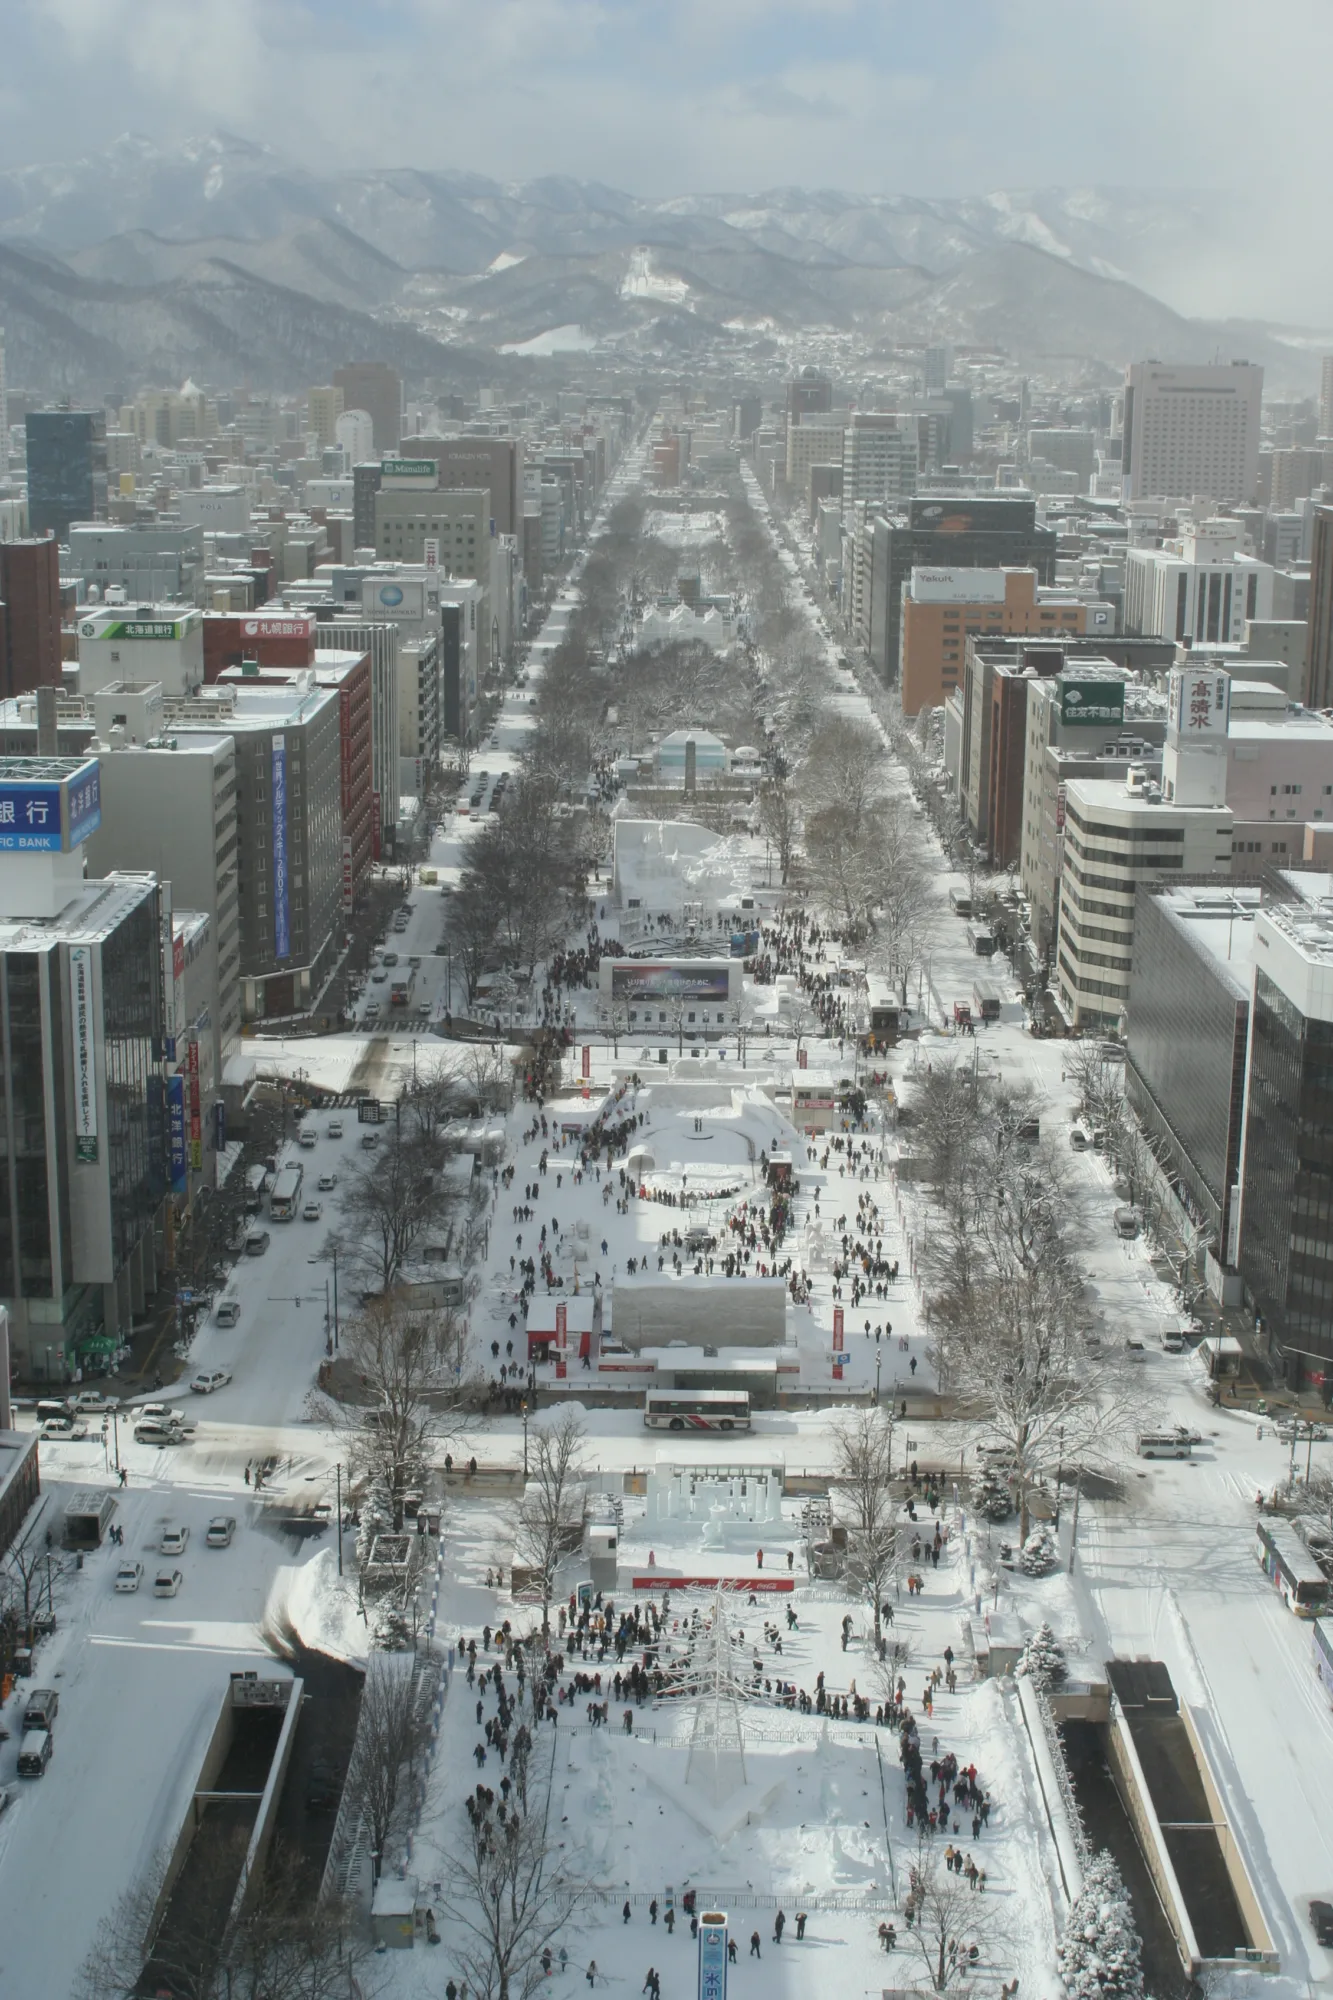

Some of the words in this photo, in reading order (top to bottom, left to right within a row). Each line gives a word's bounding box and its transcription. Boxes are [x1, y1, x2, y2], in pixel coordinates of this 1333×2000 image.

[394, 464, 431, 473] Manulife
[426, 541, 436, 568] 三井
[920, 574, 954, 583] Yakult
[1095, 612, 1106, 624] P
[125, 624, 173, 635] 北海道銀行
[260, 623, 304, 635] 札幌銀行
[1188, 680, 1213, 729] 高清水
[1065, 706, 1121, 718] 住友不動産
[19, 838, 51, 847] BANK
[171, 1103, 183, 1165] 北洋銀行
[705, 1972, 720, 2000] 氷の
